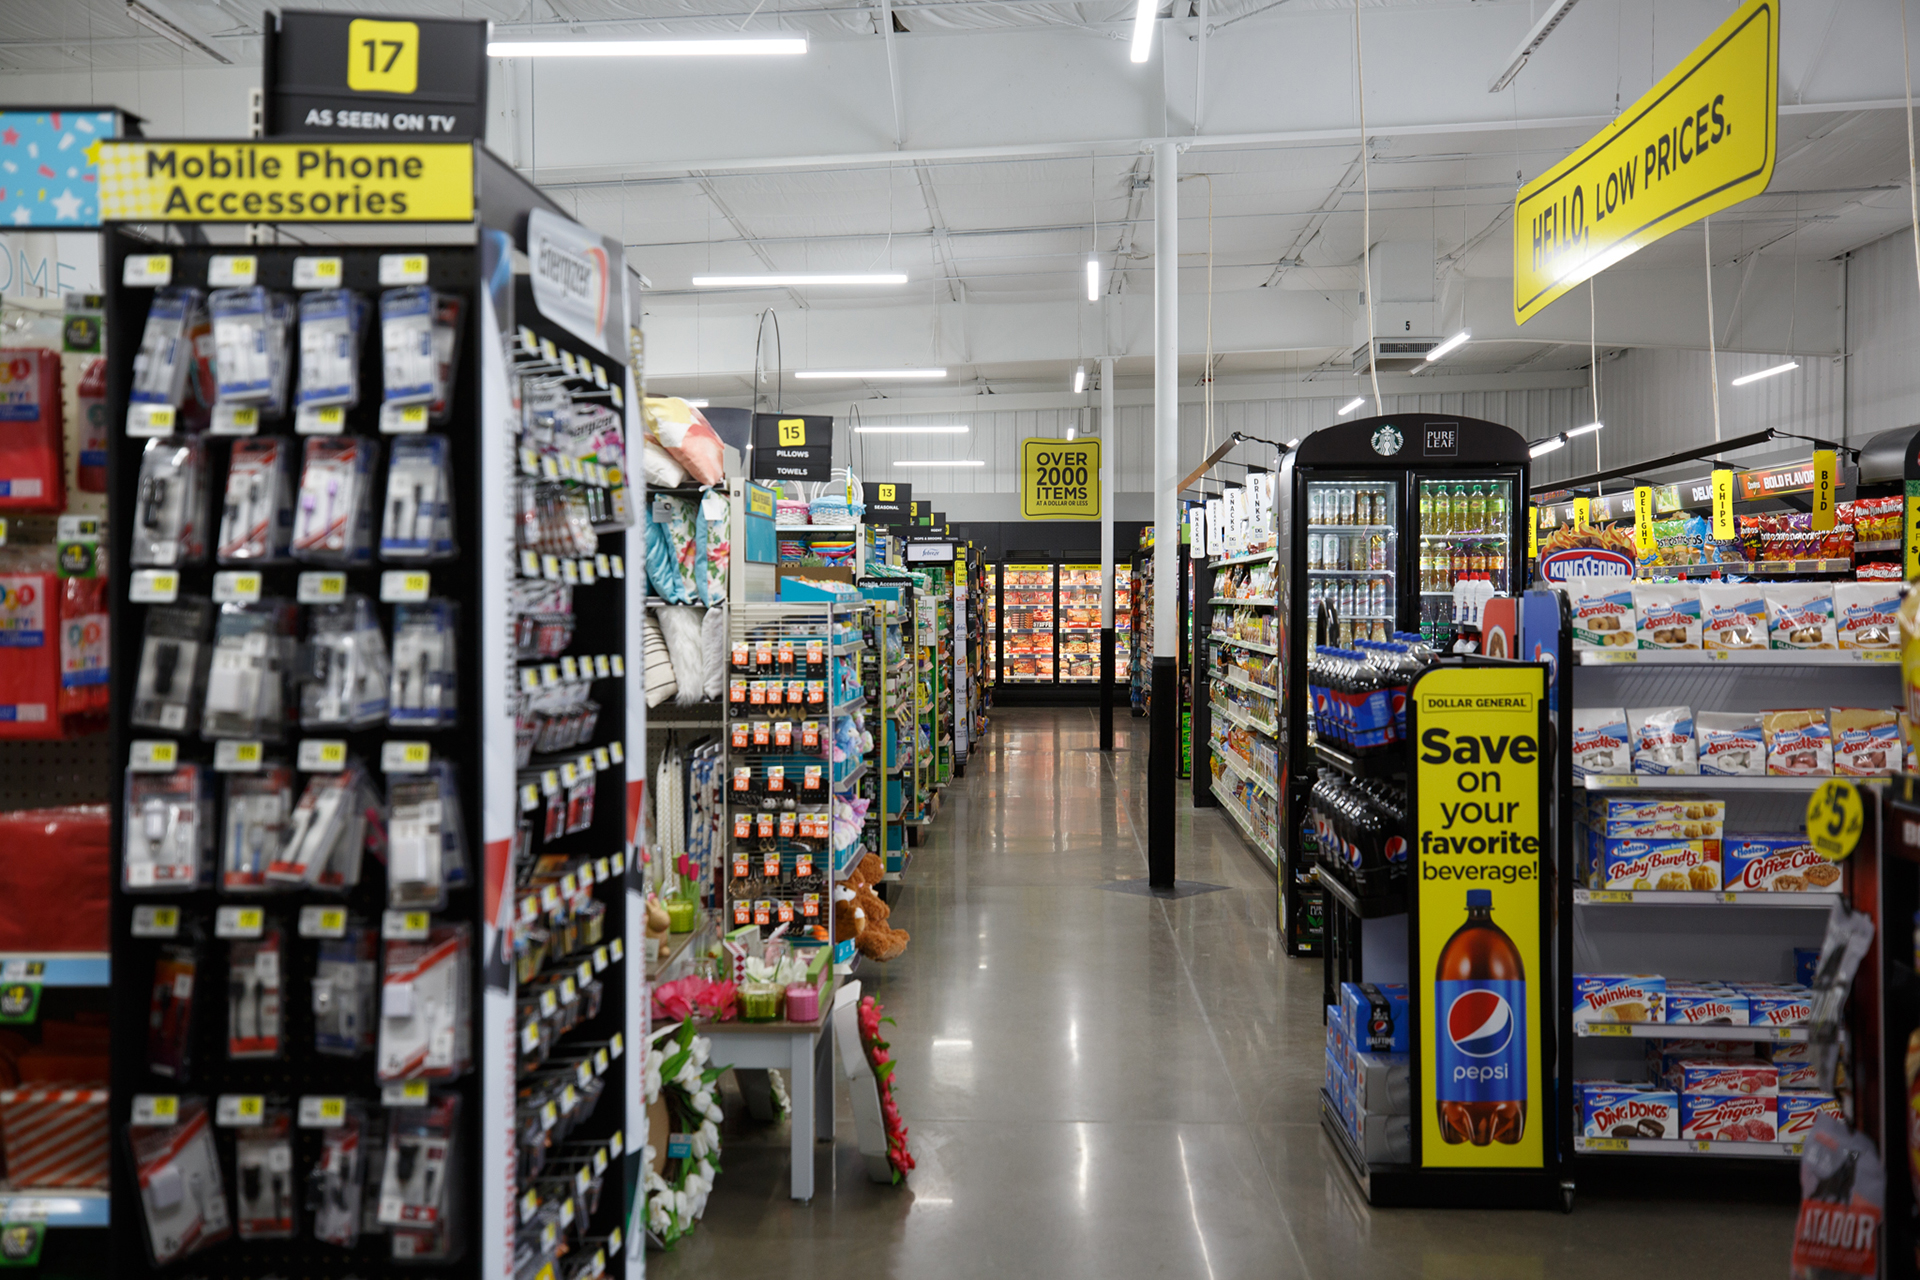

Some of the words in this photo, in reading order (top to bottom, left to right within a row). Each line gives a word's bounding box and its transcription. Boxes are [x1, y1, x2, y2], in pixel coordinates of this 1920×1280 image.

[362, 39, 404, 73] 17
[304, 108, 333, 127] AS
[336, 110, 389, 130] SEEN
[392, 112, 426, 131] ON
[428, 115, 457, 133] TV
[146, 149, 283, 180] Mobile
[297, 149, 425, 180] Phone
[1533, 185, 1589, 272] HELLO,
[1596, 155, 1638, 222] LOW
[1644, 94, 1732, 190] PRICES.
[164, 184, 409, 214] Accessories
[1405, 321, 1410, 331] 5
[783, 426, 800, 439] 15
[1427, 430, 1455, 440] PURE
[1427, 439, 1454, 448] LEAF
[776, 450, 809, 458] PILLOWS
[1036, 452, 1088, 466] OVER
[777, 467, 808, 475] TOWELS
[1036, 466, 1088, 486] 2000
[1763, 475, 1784, 490] BOLD
[1820, 470, 1829, 511] BOLD
[882, 489, 892, 497] 13
[1037, 487, 1088, 500] ITEMS
[1639, 490, 1648, 545] DELIGHT
[1578, 603, 1626, 619] donettes
[1645, 612, 1694, 630] donettes
[1711, 614, 1758, 632] donettes
[1780, 612, 1827, 630] donettes
[1846, 612, 1895, 631] donettes
[1576, 629, 1600, 640] GLAZED
[1428, 698, 1473, 708] DOLLAR
[1476, 698, 1527, 708] GENERAL
[1420, 727, 1538, 765] Save
[1573, 736, 1620, 754] donettes
[1708, 738, 1756, 754] donettes
[1776, 737, 1823, 755] donettes
[1637, 760, 1667, 773] POWDERED
[1457, 771, 1501, 793] on
[1440, 801, 1520, 830] your
[1636, 808, 1658, 819] Baby
[1656, 804, 1683, 814] Bundts
[1635, 826, 1655, 837] Baby
[1654, 822, 1681, 832] Bundts
[1421, 830, 1540, 854] favorite
[1653, 844, 1670, 852] Lemon
[1737, 845, 1768, 857] Hostess
[1773, 845, 1802, 856] Cinnamon
[1423, 860, 1538, 884] beverage!
[1611, 860, 1650, 880] Baby
[1648, 850, 1701, 868] Bundts
[1744, 857, 1792, 889] Coffee
[1585, 986, 1643, 1010] Twinkies
[1454, 1062, 1509, 1083] pepsi
[1702, 1073, 1742, 1090] Zingers
[1628, 1100, 1668, 1120] DONGS
[1692, 1104, 1765, 1132] Zingers
